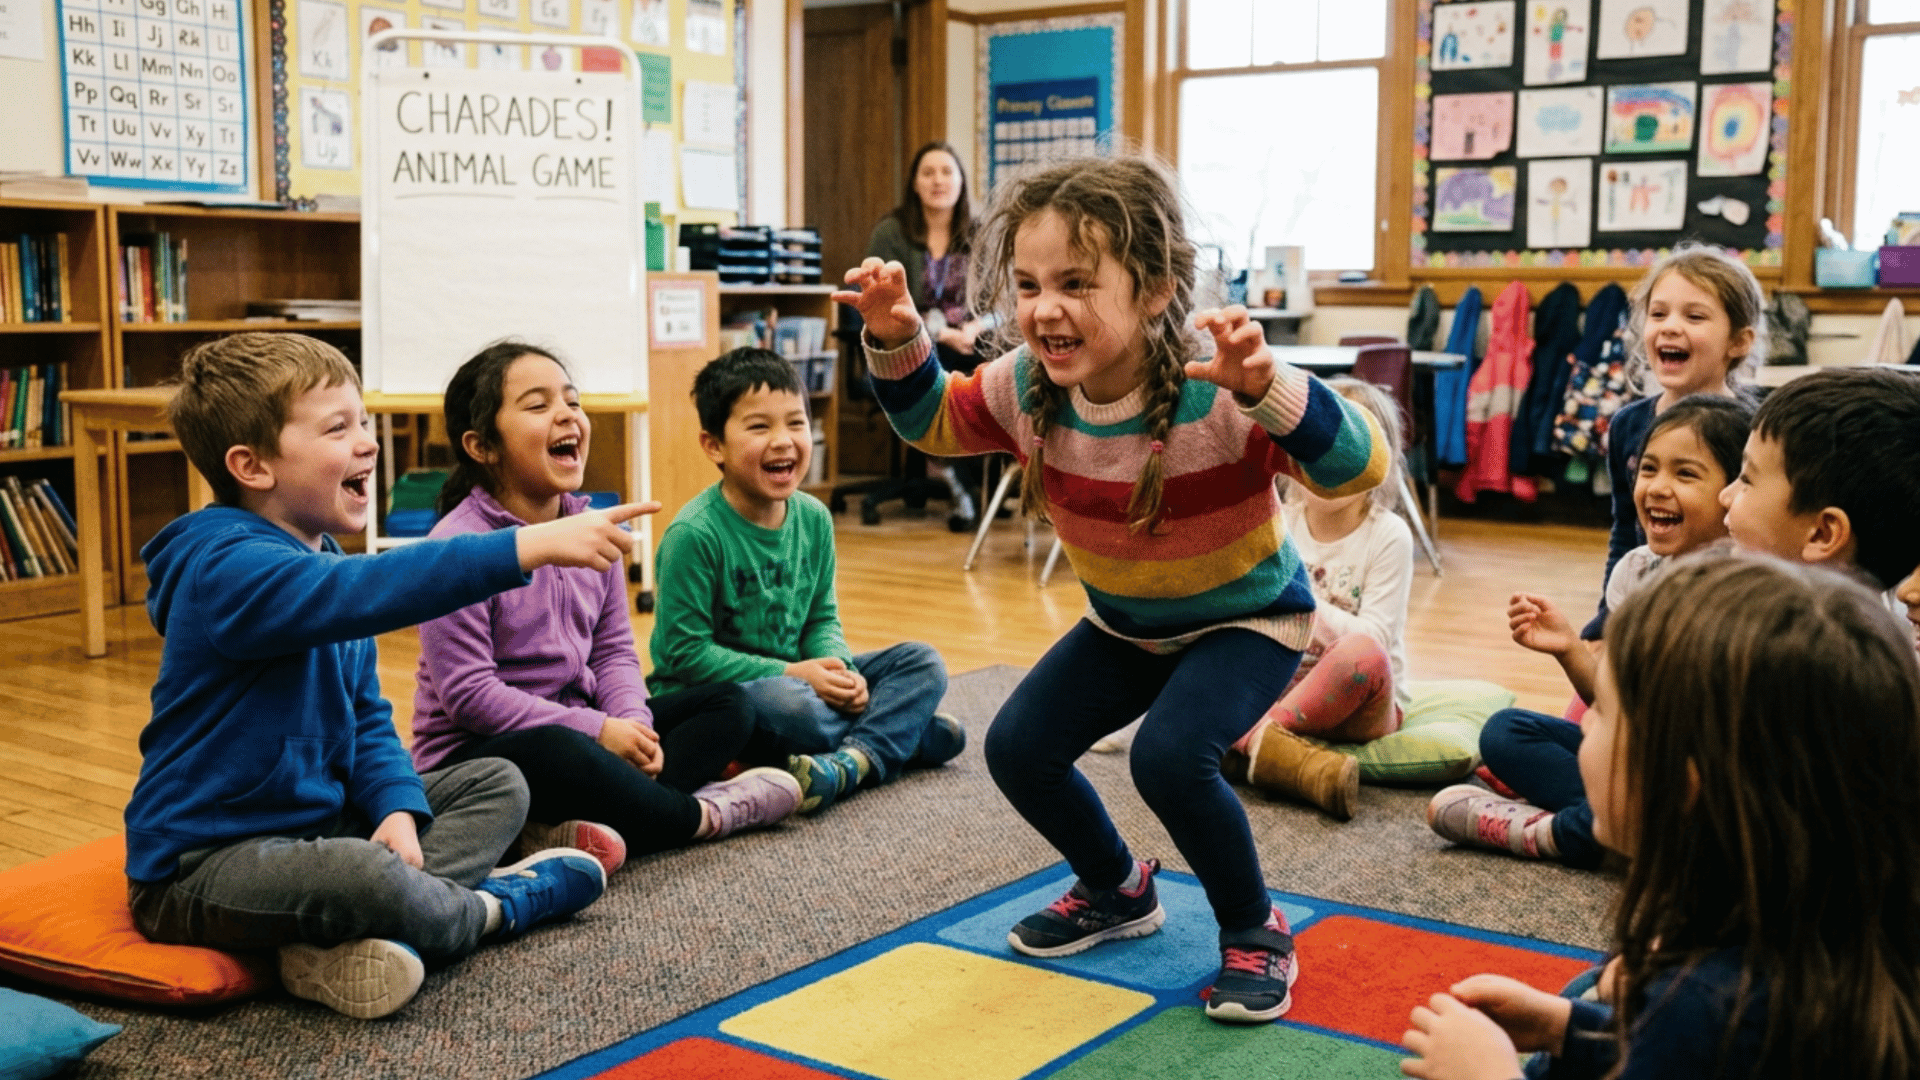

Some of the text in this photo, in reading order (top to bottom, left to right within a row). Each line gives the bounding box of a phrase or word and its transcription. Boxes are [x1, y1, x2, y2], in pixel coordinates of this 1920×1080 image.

[68, 14, 95, 34] Hh
[112, 19, 126, 38] Ii
[147, 24, 164, 49] Jj
[72, 47, 238, 84] Kk Ll Mm Nn Oo
[73, 81, 98, 105] Pp
[108, 85, 138, 110] Qq
[148, 88, 168, 107] Rr
[77, 114, 97, 133] Tt
[111, 118, 137, 137] Uu
[149, 121, 172, 139] Vv
[184, 125, 205, 147] Xy
[396, 91, 614, 143] CHARADES!
[76, 148, 101, 167] Vv
[110, 150, 142, 169] Ww
[150, 154, 173, 171] Xx
[184, 156, 206, 179] Yy
[392, 150, 616, 189] ANIMAL GAME
